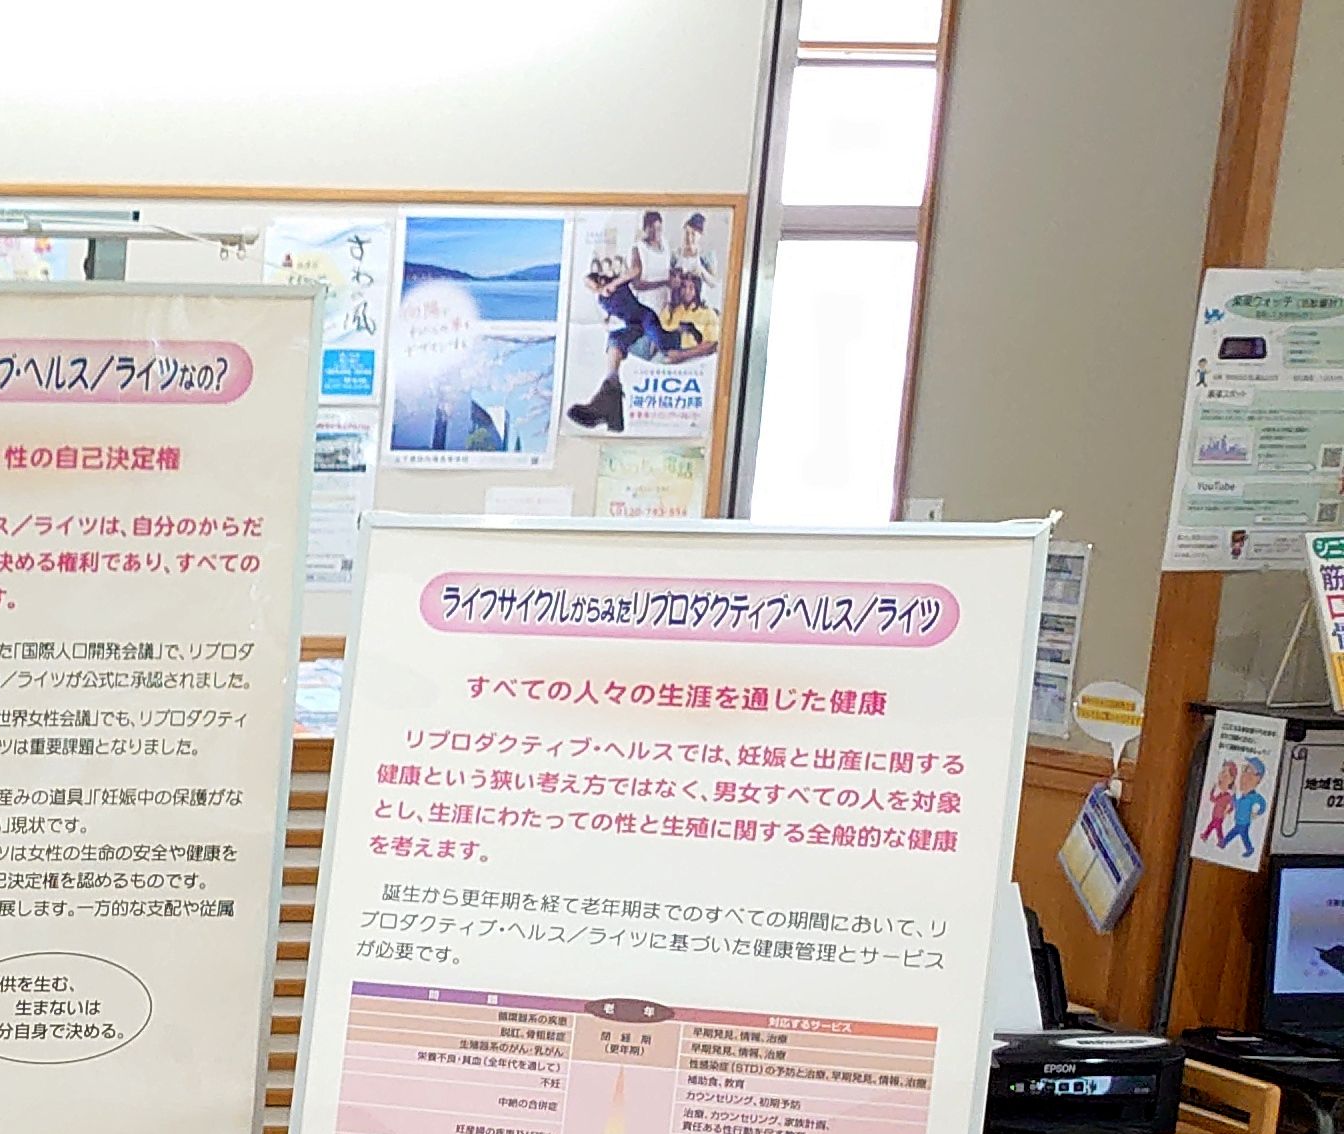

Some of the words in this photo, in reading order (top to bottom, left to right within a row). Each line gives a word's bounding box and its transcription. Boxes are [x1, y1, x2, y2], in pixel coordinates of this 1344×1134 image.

[633, 377, 701, 393] JICA
[630, 395, 703, 409] 海外協力隊
[1197, 482, 1235, 492] YouTube
[466, 675, 888, 717] すべての人々の生涯を通じた健康
[369, 835, 491, 864] を考えます。
[356, 942, 463, 966] が必要です。
[15, 998, 101, 1018] 生まないは
[768, 1017, 852, 1034] 対応するサービス
[1043, 1063, 1076, 1073] EPSON
[540, 1077, 561, 1089] 不妊
